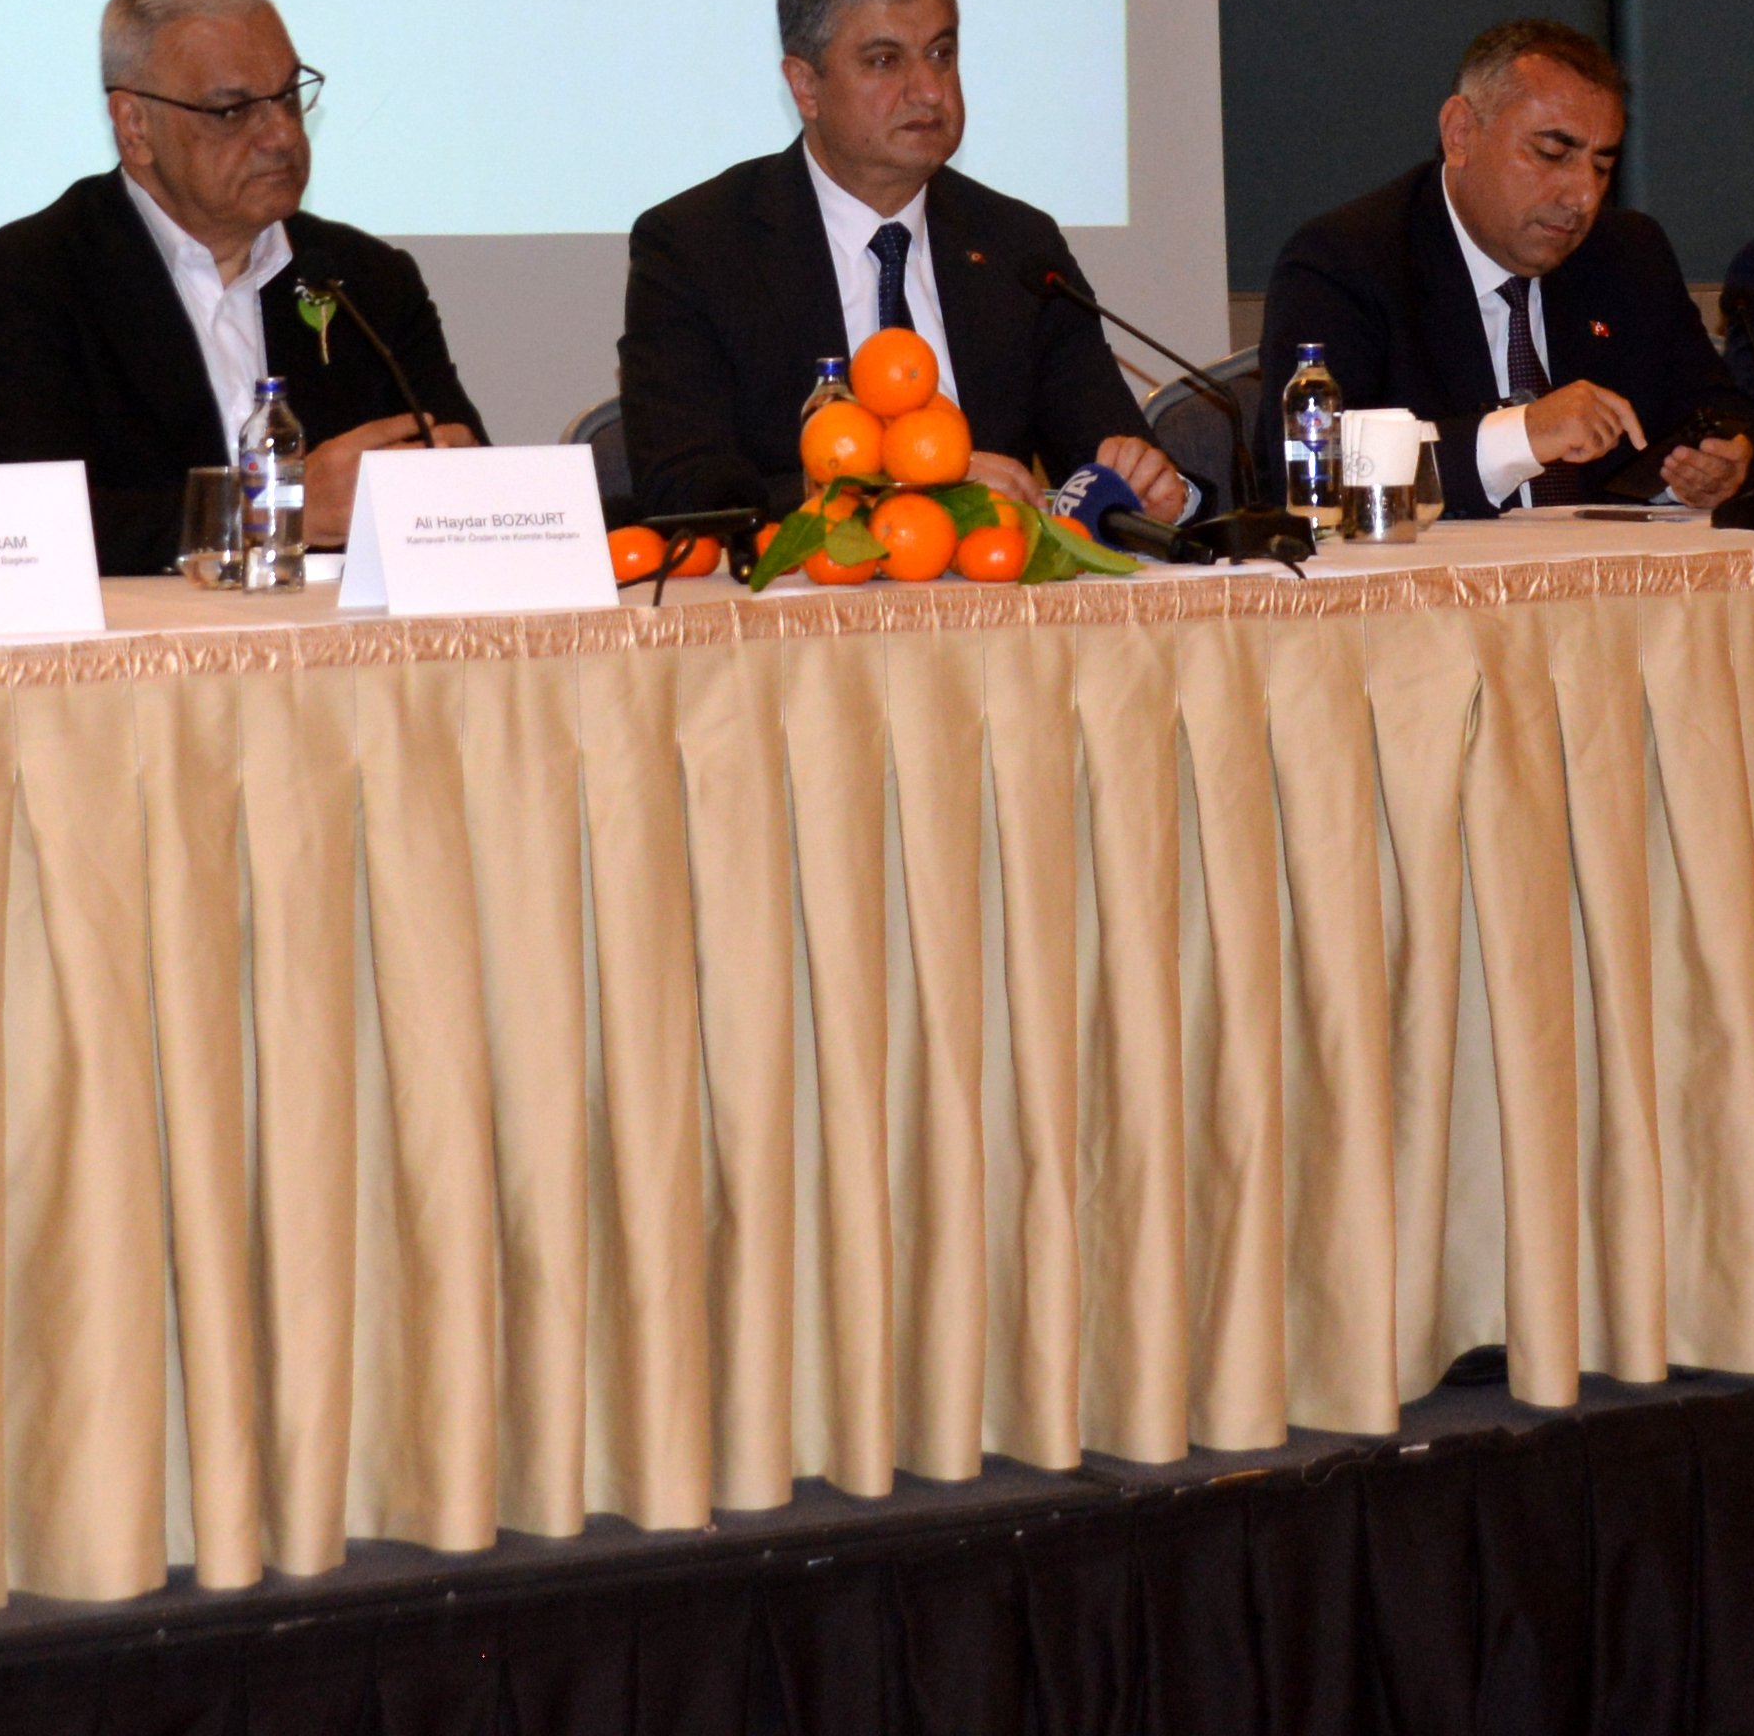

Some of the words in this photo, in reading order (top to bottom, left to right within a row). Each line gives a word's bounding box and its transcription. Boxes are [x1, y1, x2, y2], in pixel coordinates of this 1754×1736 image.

[415, 516, 434, 529] Ali
[437, 515, 487, 532] Haydar
[492, 512, 566, 528] BOZKURT
